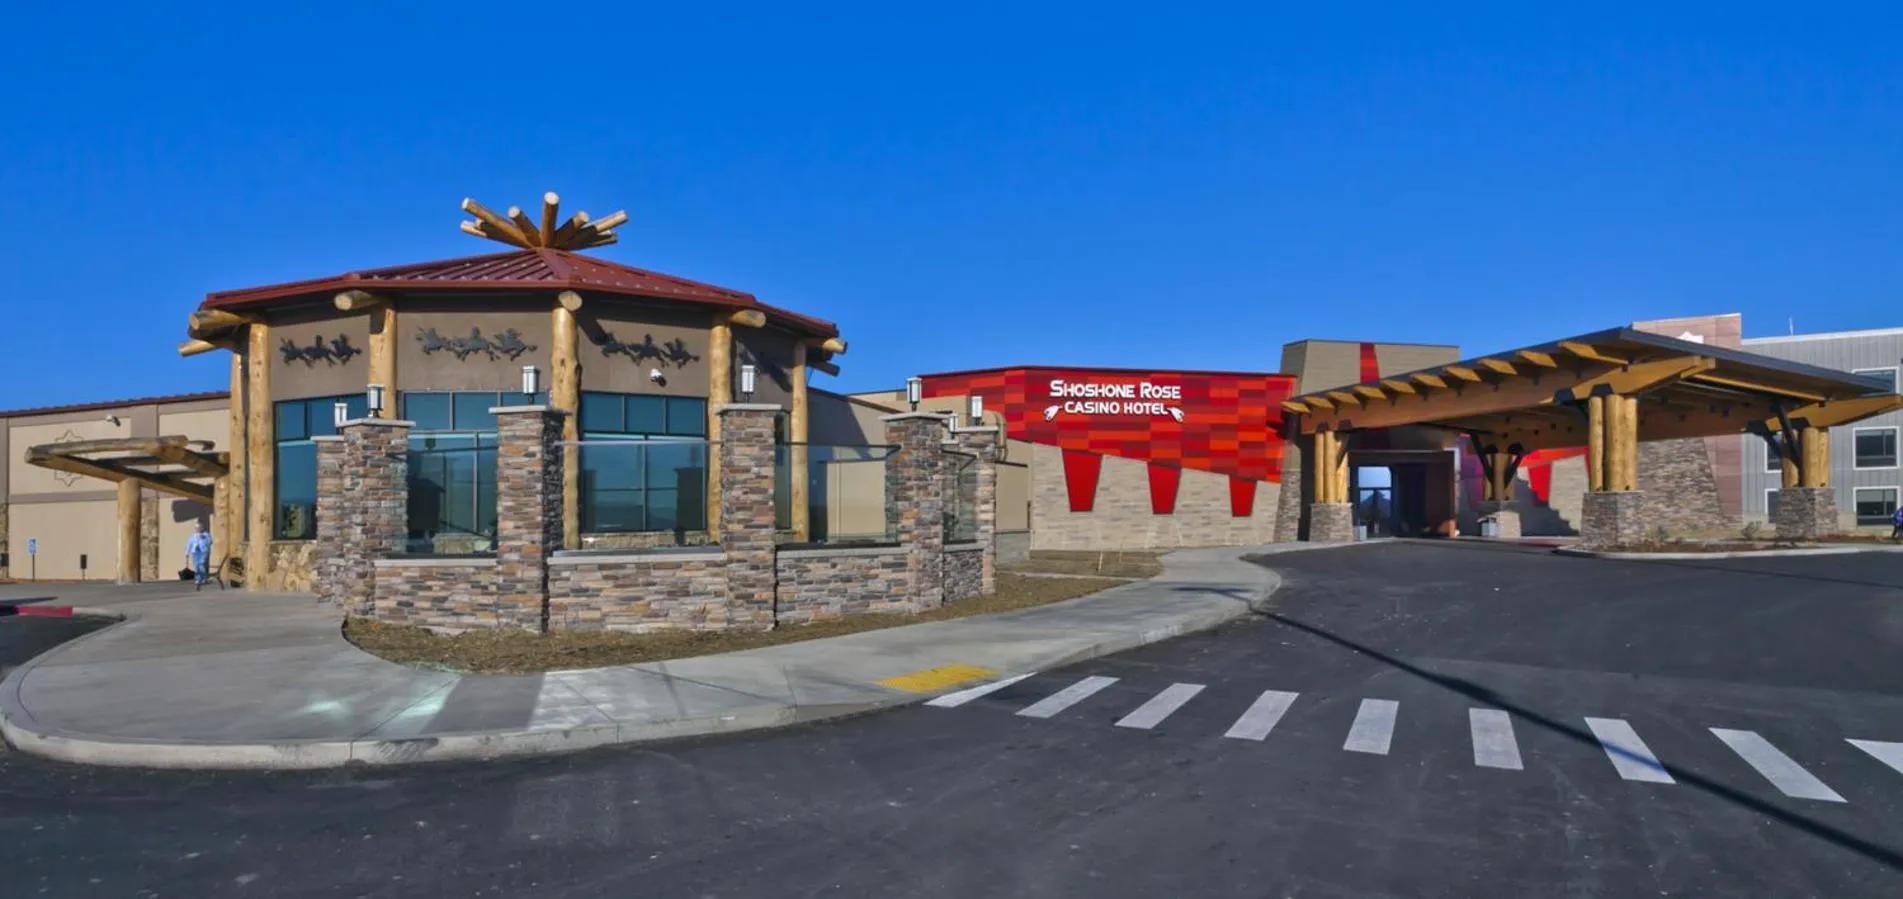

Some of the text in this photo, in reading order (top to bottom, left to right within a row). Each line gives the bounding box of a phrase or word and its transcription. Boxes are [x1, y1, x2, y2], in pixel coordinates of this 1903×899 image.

[1050, 380, 1181, 399] SHOSHONE ROSE
[1064, 401, 1168, 415] CASINO HOTEL
